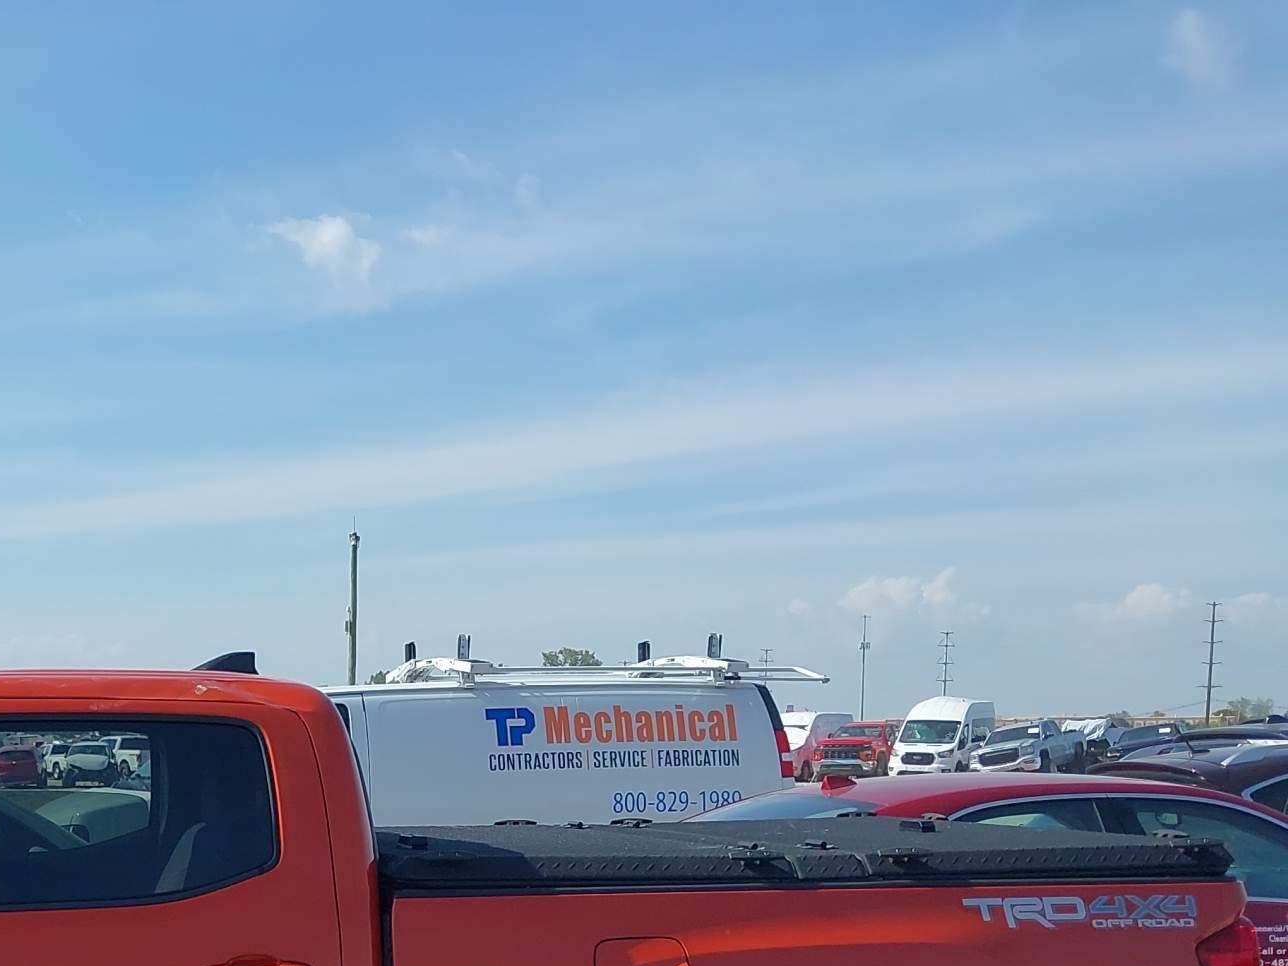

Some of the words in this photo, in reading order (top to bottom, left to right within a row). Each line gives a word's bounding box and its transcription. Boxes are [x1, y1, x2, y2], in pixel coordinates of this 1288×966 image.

[485, 707, 536, 747] TP
[543, 704, 737, 745] Mechanical
[489, 751, 583, 772] CONTRACTORS
[593, 750, 648, 769] SERVICE
[657, 748, 740, 768] FABRICATION
[1092, 919, 1134, 928] OFF
[1138, 918, 1196, 928] ROAD
